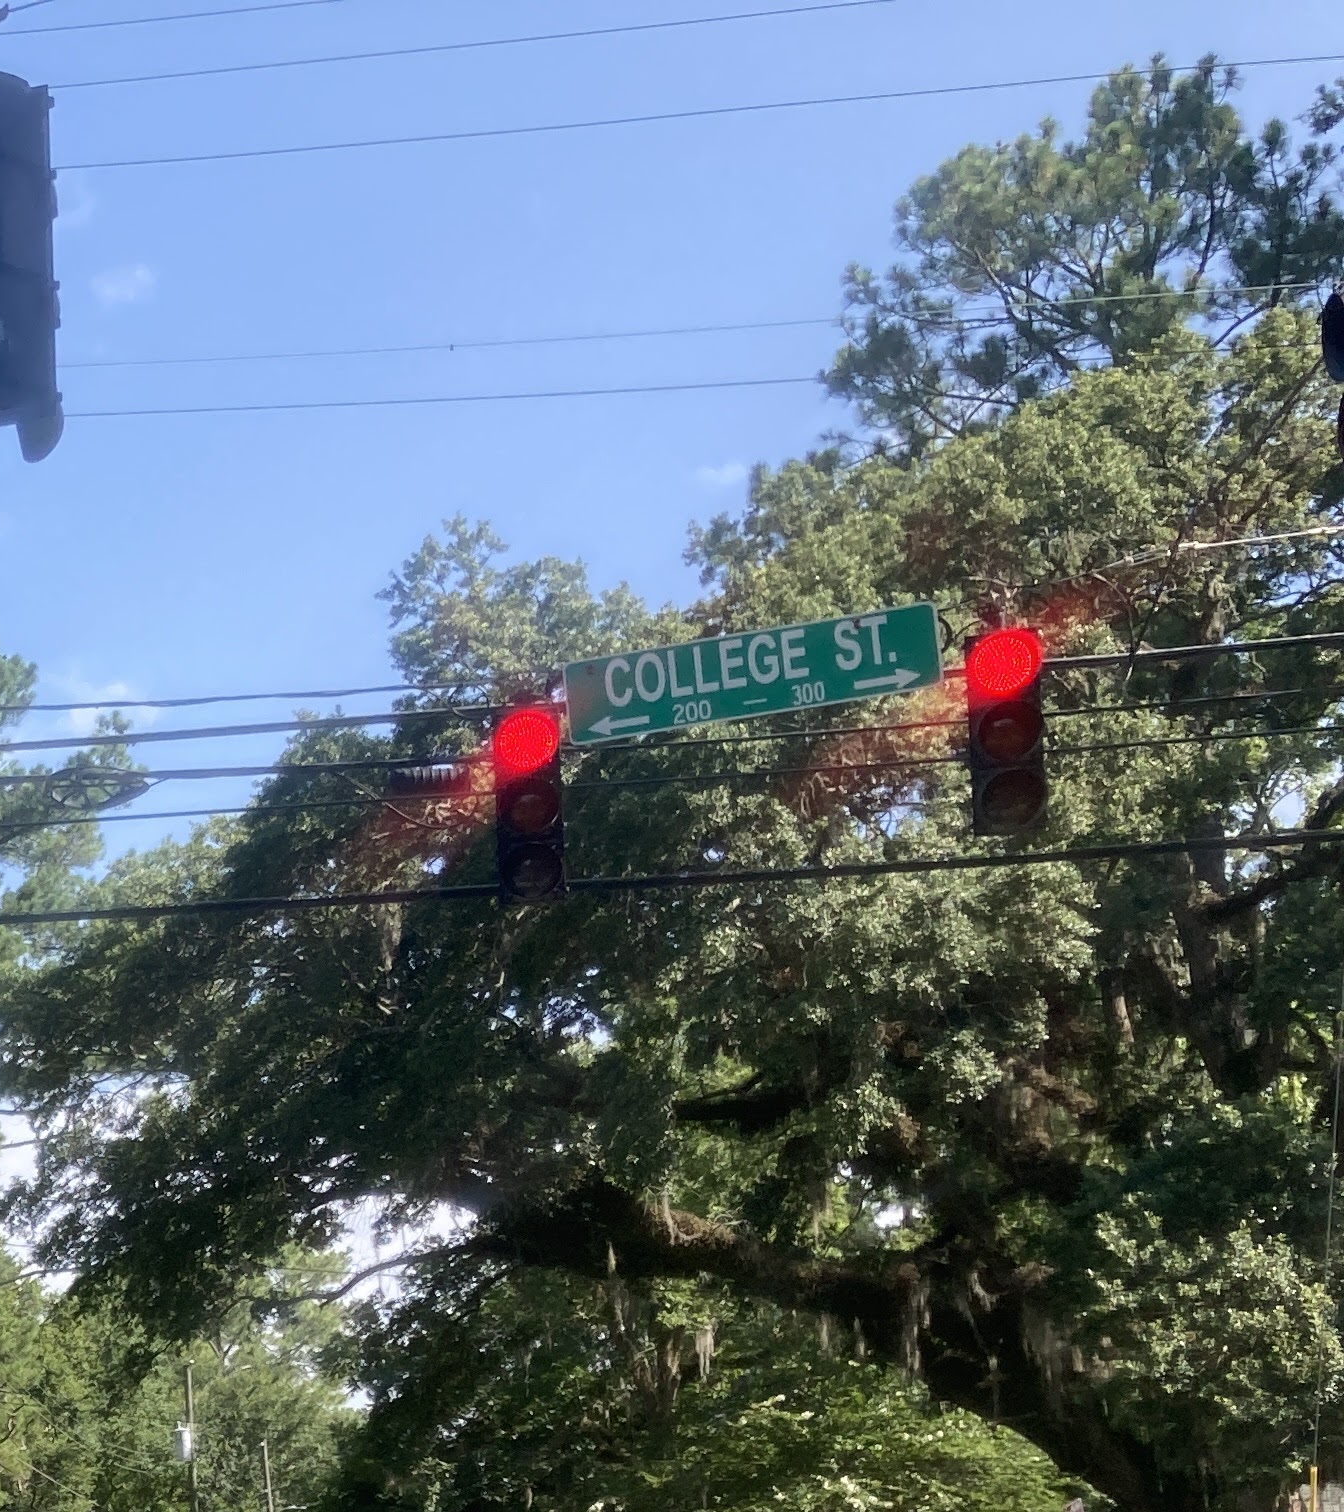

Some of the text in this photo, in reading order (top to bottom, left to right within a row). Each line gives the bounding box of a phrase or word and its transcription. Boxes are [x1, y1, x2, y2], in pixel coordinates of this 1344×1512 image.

[605, 614, 897, 707] COLLEGE ST.
[672, 700, 712, 725] 200
[791, 681, 826, 706] 300
